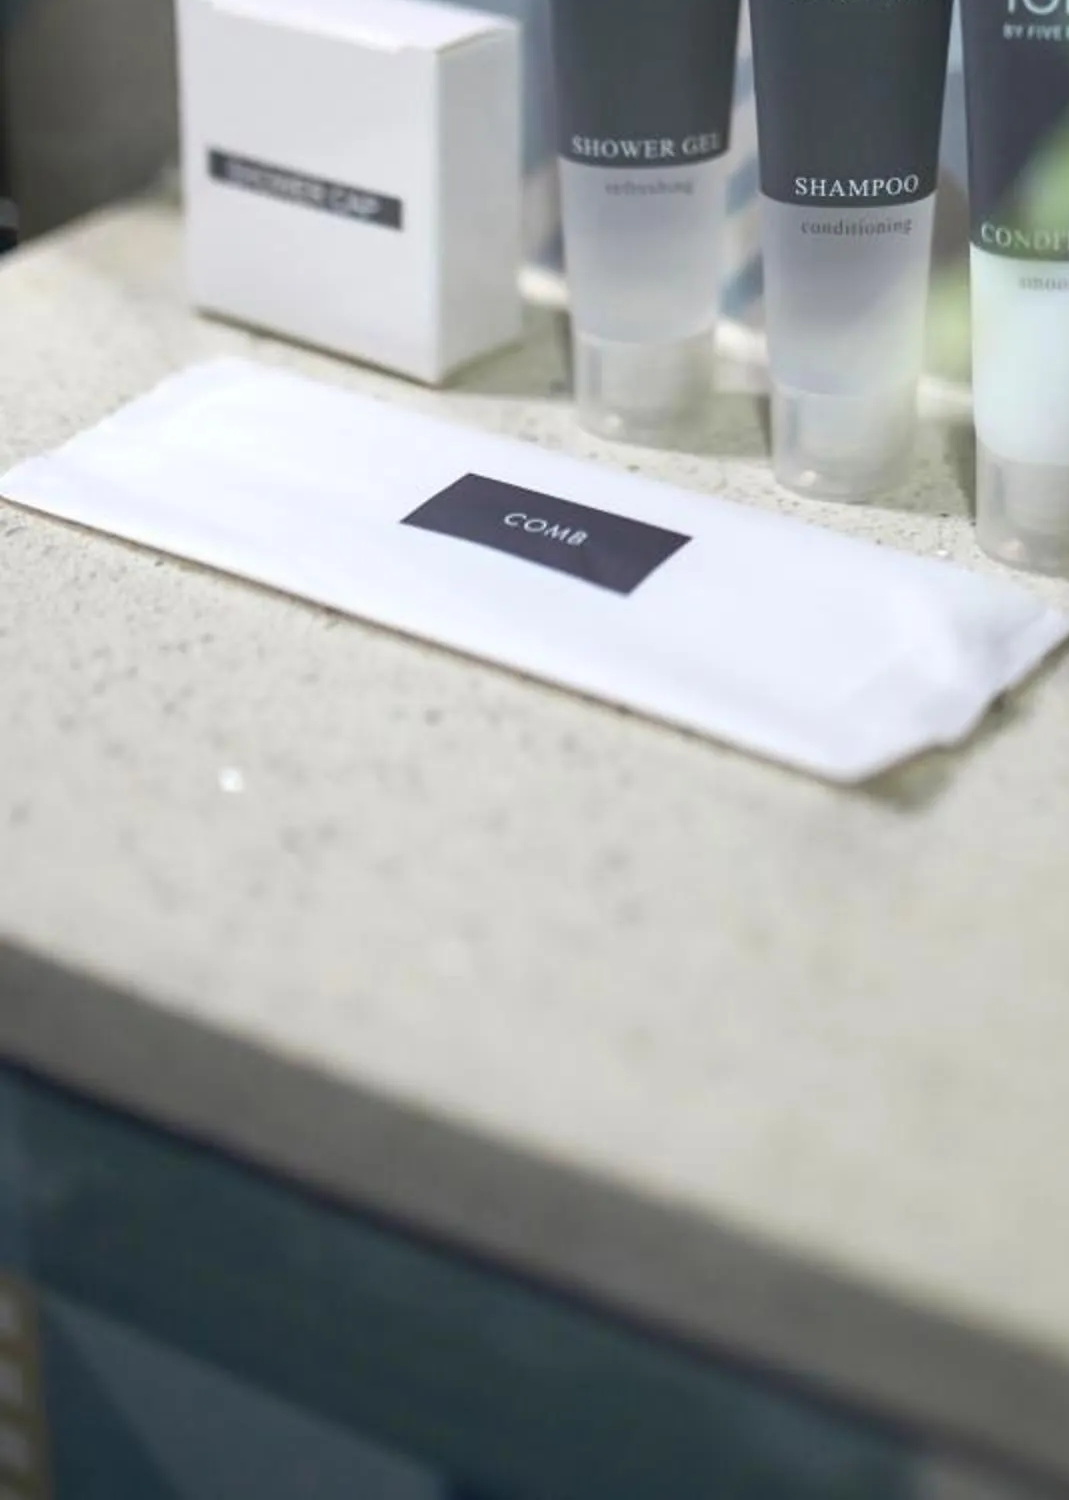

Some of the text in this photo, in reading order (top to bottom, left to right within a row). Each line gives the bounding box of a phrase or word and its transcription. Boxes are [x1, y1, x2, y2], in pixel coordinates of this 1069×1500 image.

[1003, 23, 1024, 40] BY
[1027, 24, 1062, 41] FIVE
[571, 132, 721, 159] SHOWER GEL
[794, 174, 920, 197] SHAMPOO
[801, 217, 912, 237] conditioning
[504, 513, 588, 546] COMB
